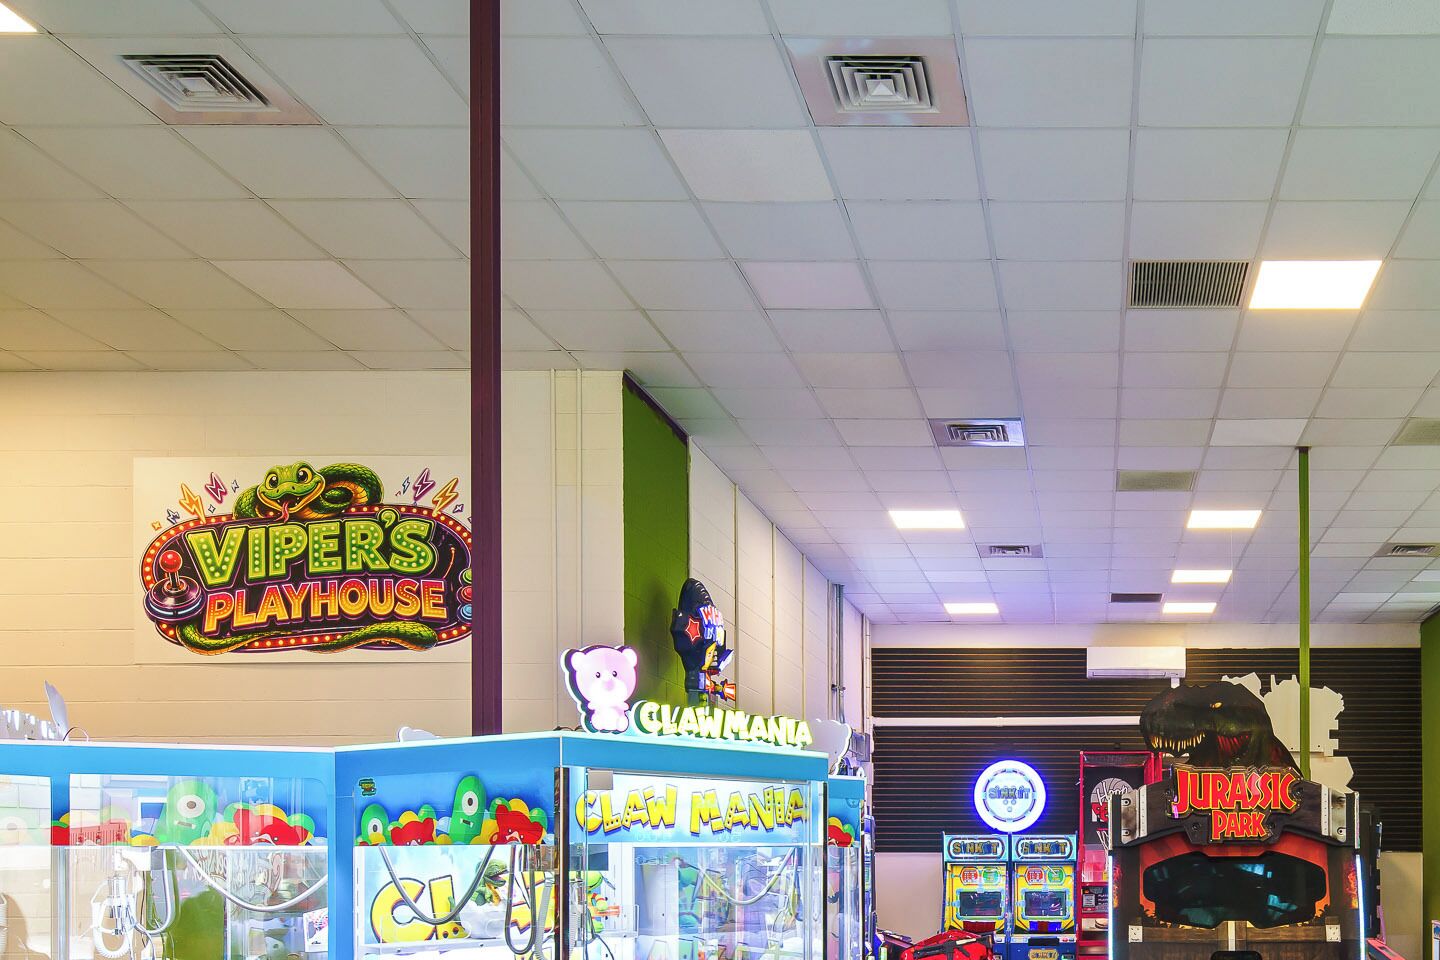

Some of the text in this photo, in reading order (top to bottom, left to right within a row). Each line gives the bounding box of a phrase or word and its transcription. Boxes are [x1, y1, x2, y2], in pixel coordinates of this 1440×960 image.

[187, 508, 438, 587] VIPER'S
[203, 579, 447, 634] PLAYHOUSE
[575, 784, 809, 837] CLAW MANIA
[1174, 769, 1296, 814] JURASSIC
[1211, 810, 1267, 840] PARK
